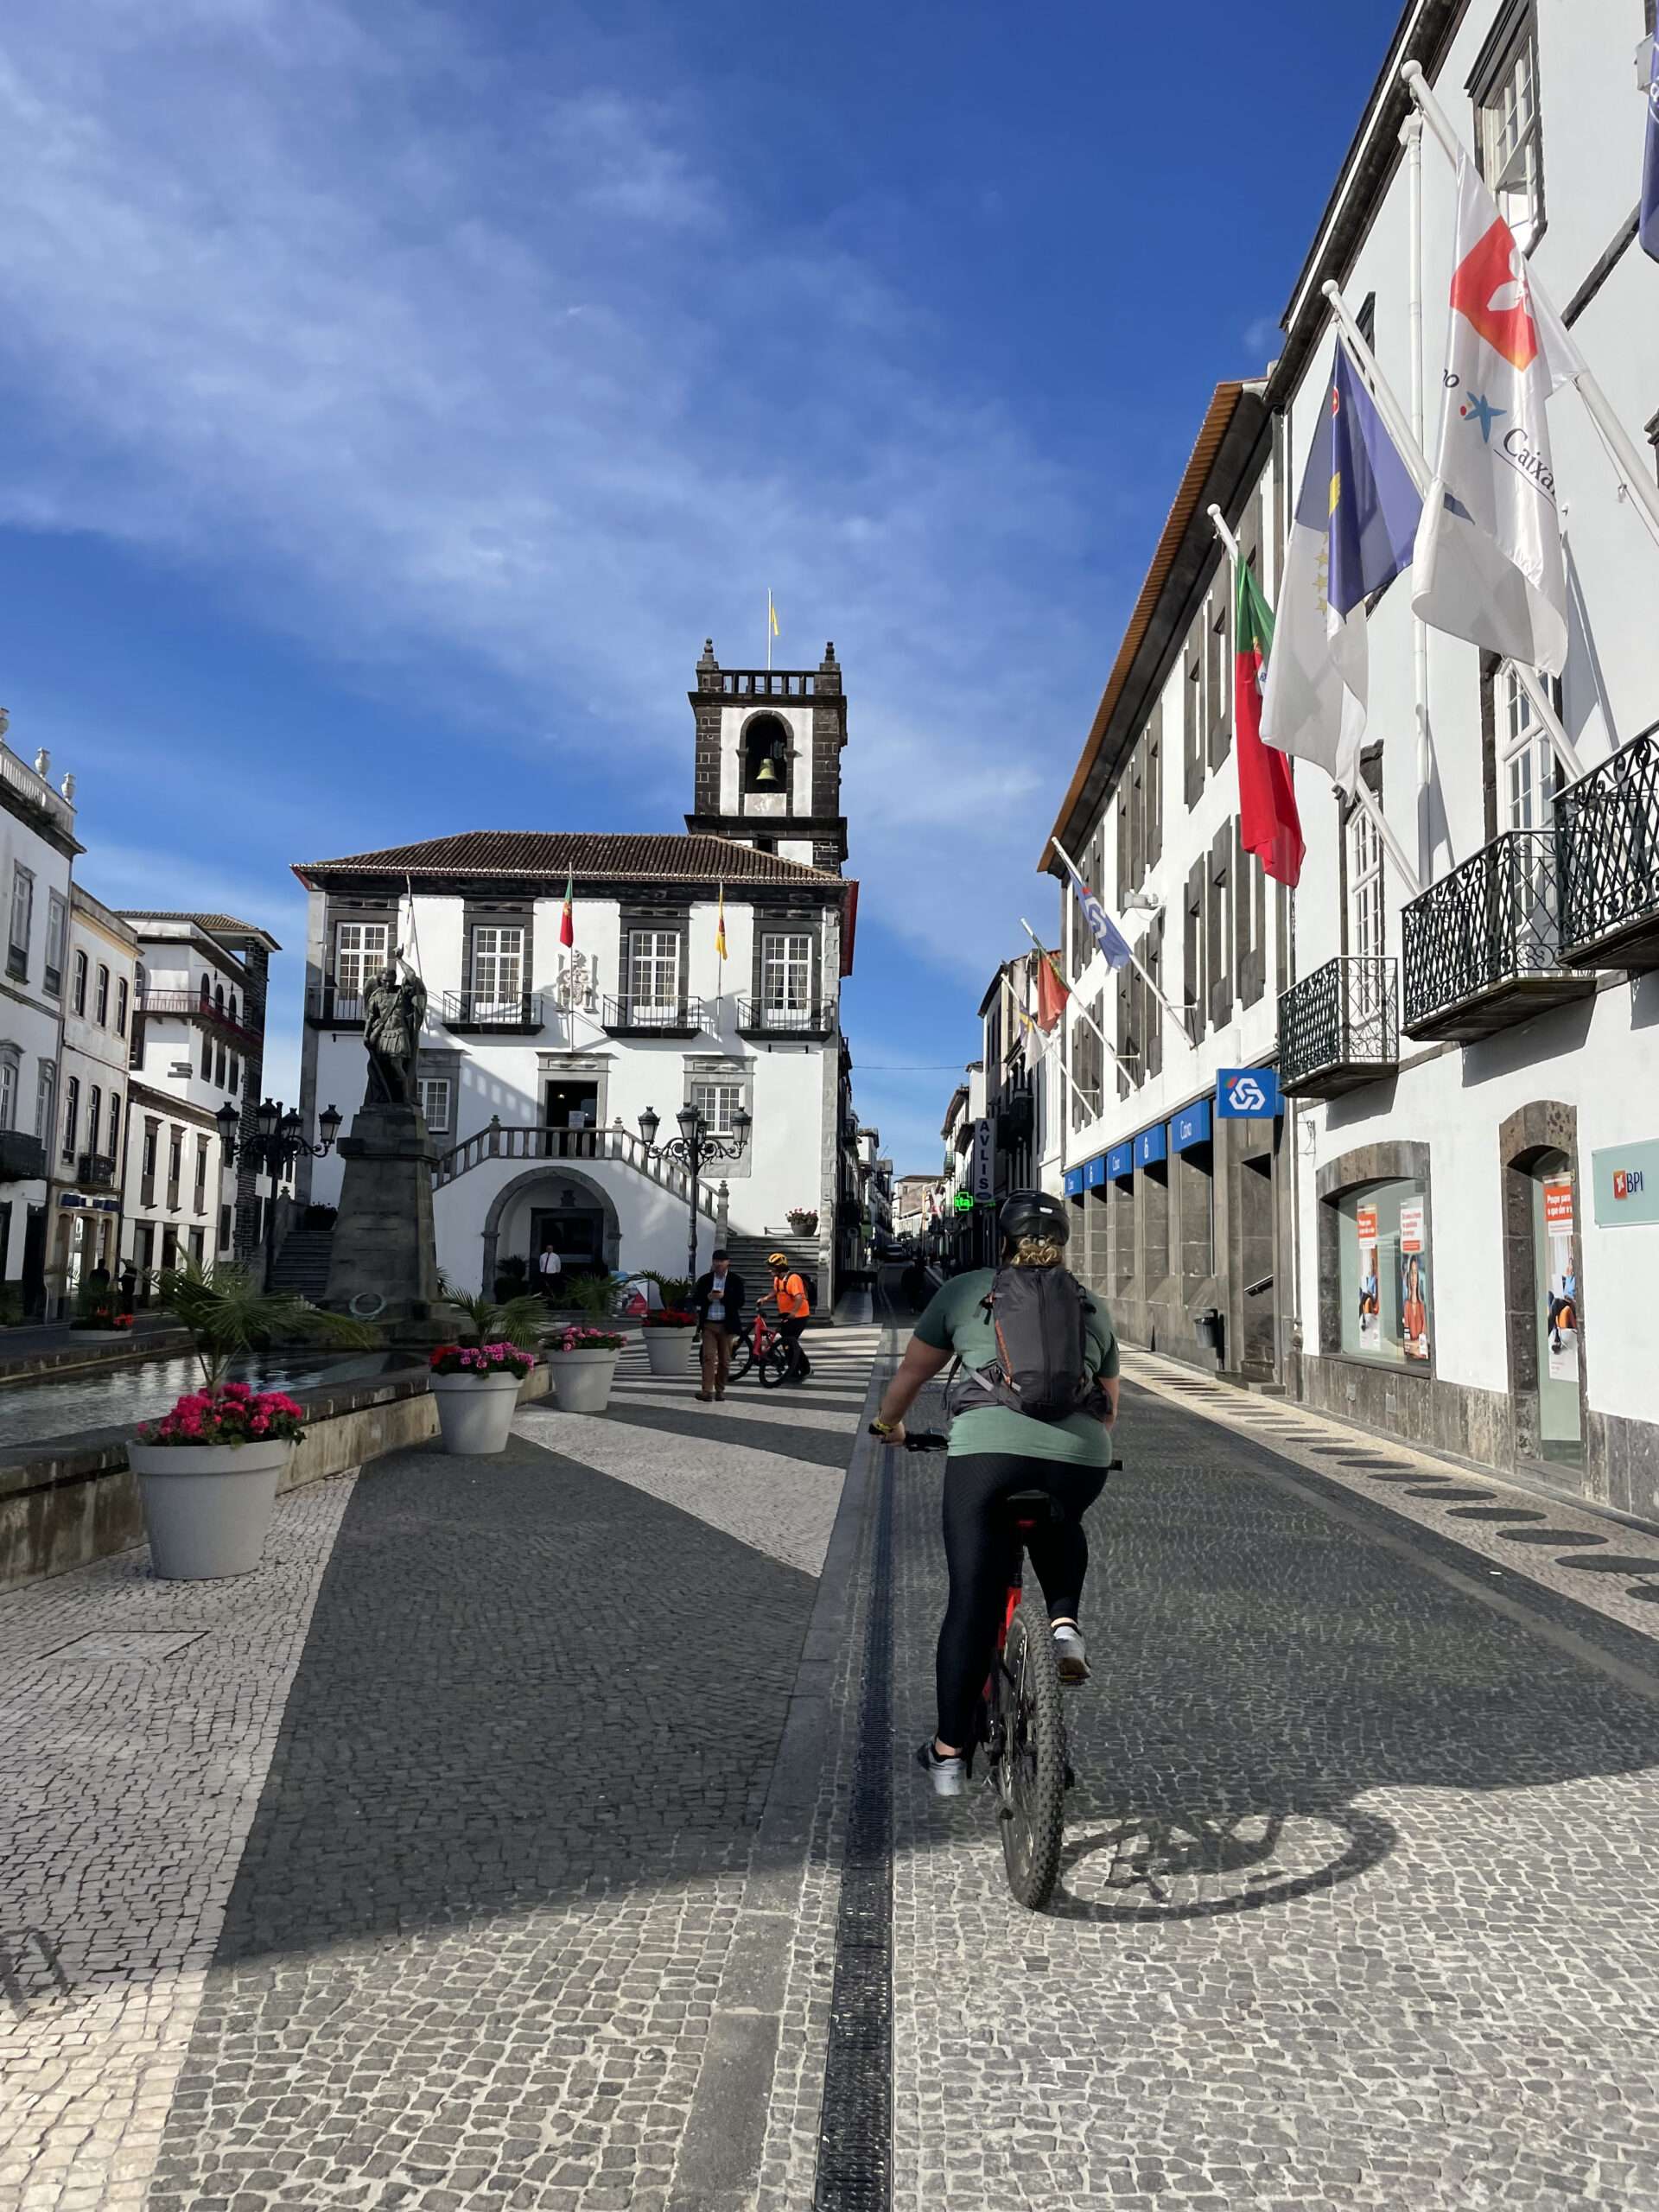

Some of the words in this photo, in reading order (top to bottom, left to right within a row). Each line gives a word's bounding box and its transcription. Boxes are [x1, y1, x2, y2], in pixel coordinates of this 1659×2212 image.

[1503, 428, 1556, 497] Caixa
[979, 1121, 990, 1190] AVLIS
[1626, 1171, 1643, 1193] BPI
